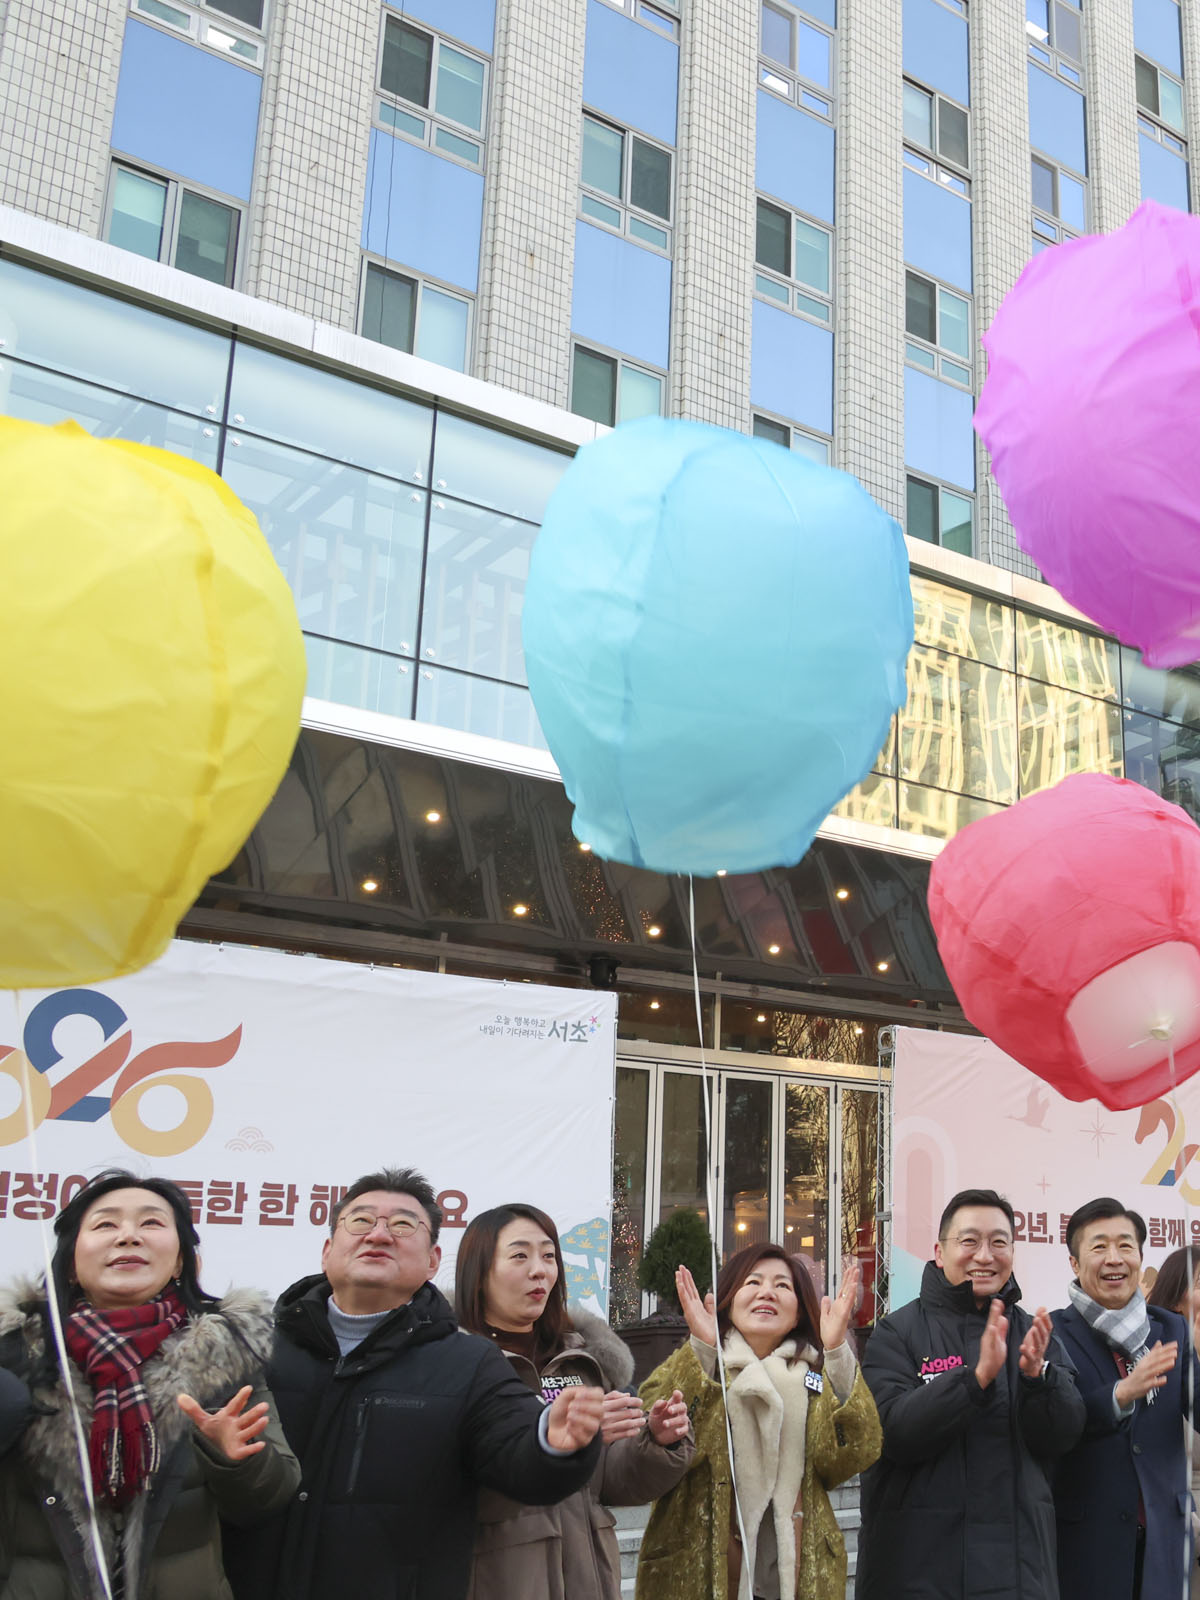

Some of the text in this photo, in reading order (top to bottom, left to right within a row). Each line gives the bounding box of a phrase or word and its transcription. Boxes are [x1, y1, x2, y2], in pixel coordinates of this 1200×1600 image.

[494, 1014, 546, 1028] 오늘 행복하고
[479, 1025, 546, 1040] 내일이 기다려지는
[547, 1020, 588, 1043] 서초
[259, 1182, 299, 1227] 한
[1148, 1217, 1186, 1248] 함께
[540, 1375, 584, 1388] 서초구의원
